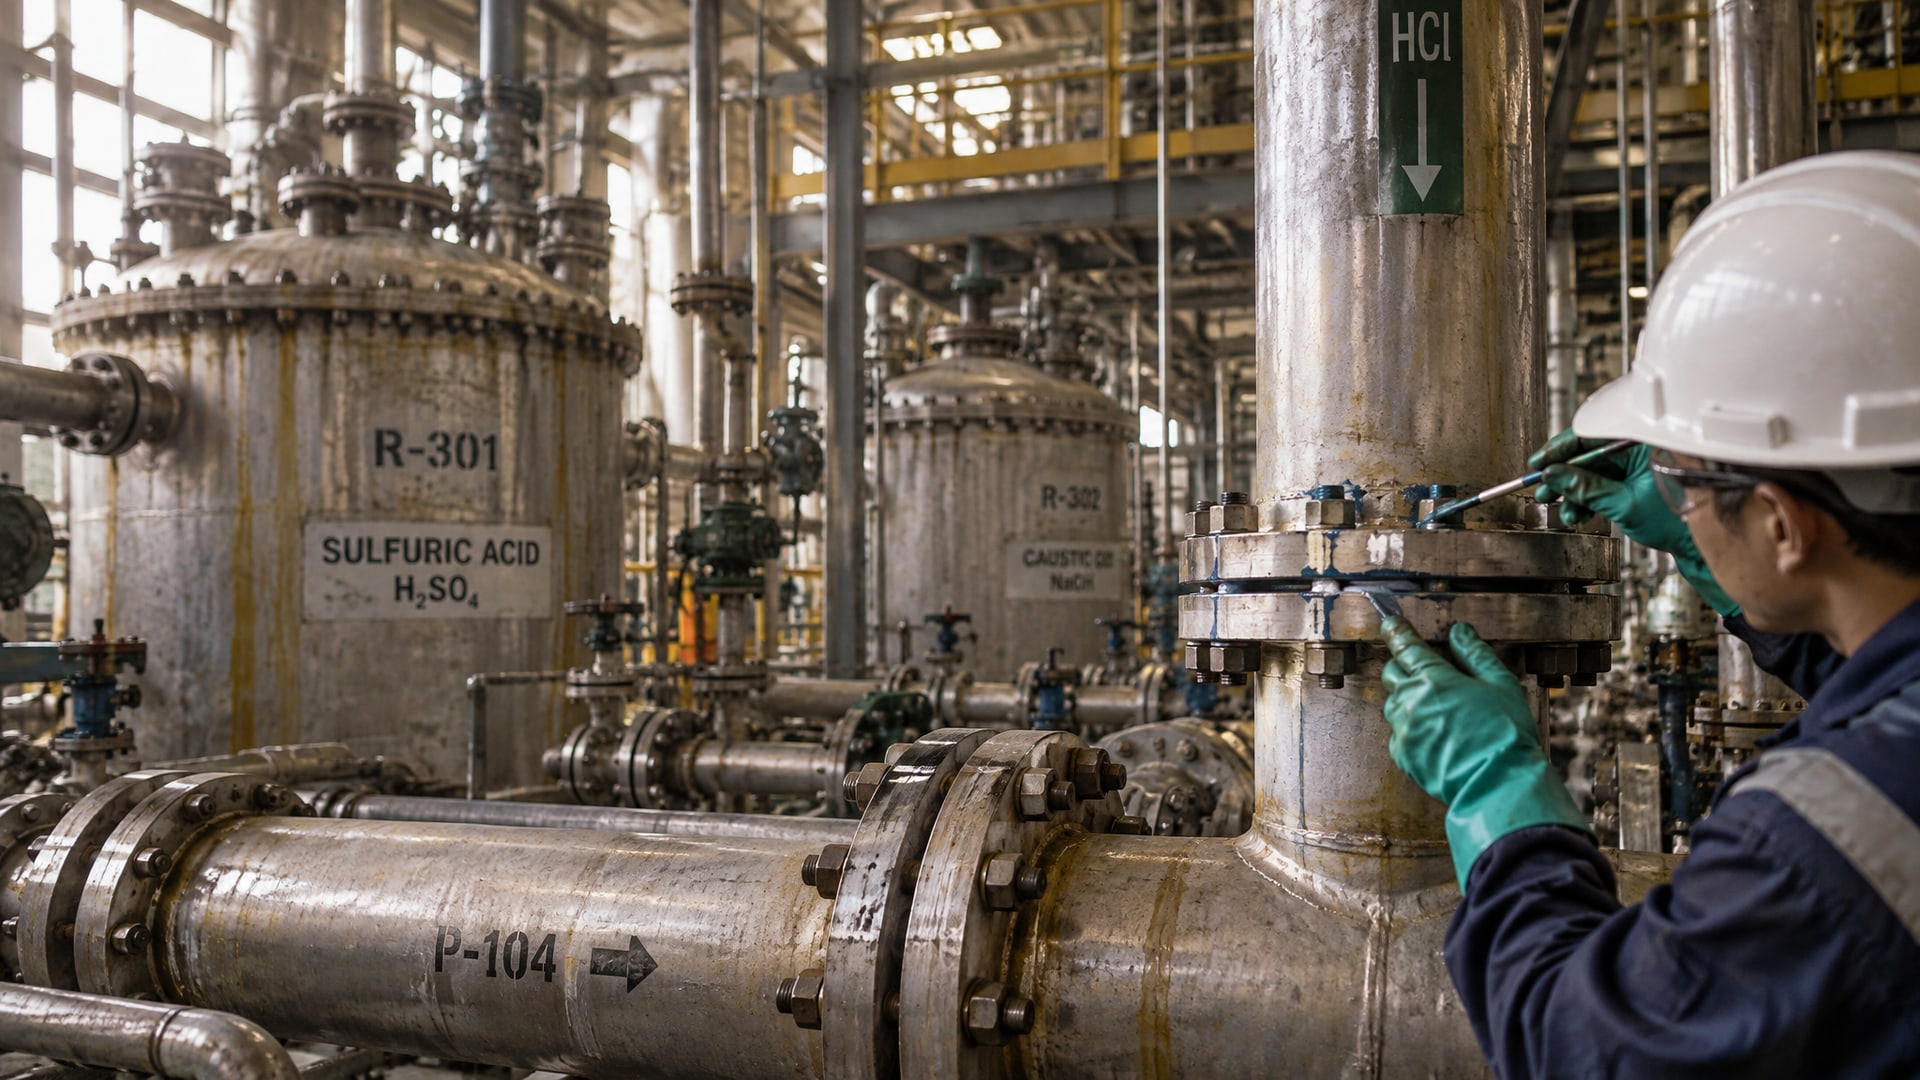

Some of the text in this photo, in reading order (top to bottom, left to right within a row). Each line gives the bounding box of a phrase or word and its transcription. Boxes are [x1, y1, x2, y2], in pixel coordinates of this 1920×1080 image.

[1391, 11, 1451, 62] HCl
[374, 429, 497, 471] R-301
[1041, 485, 1101, 511] R-302
[322, 536, 540, 565] SULFURIC ACID
[1023, 549, 1092, 567] CAUSTIC
[434, 925, 556, 982] P-104
